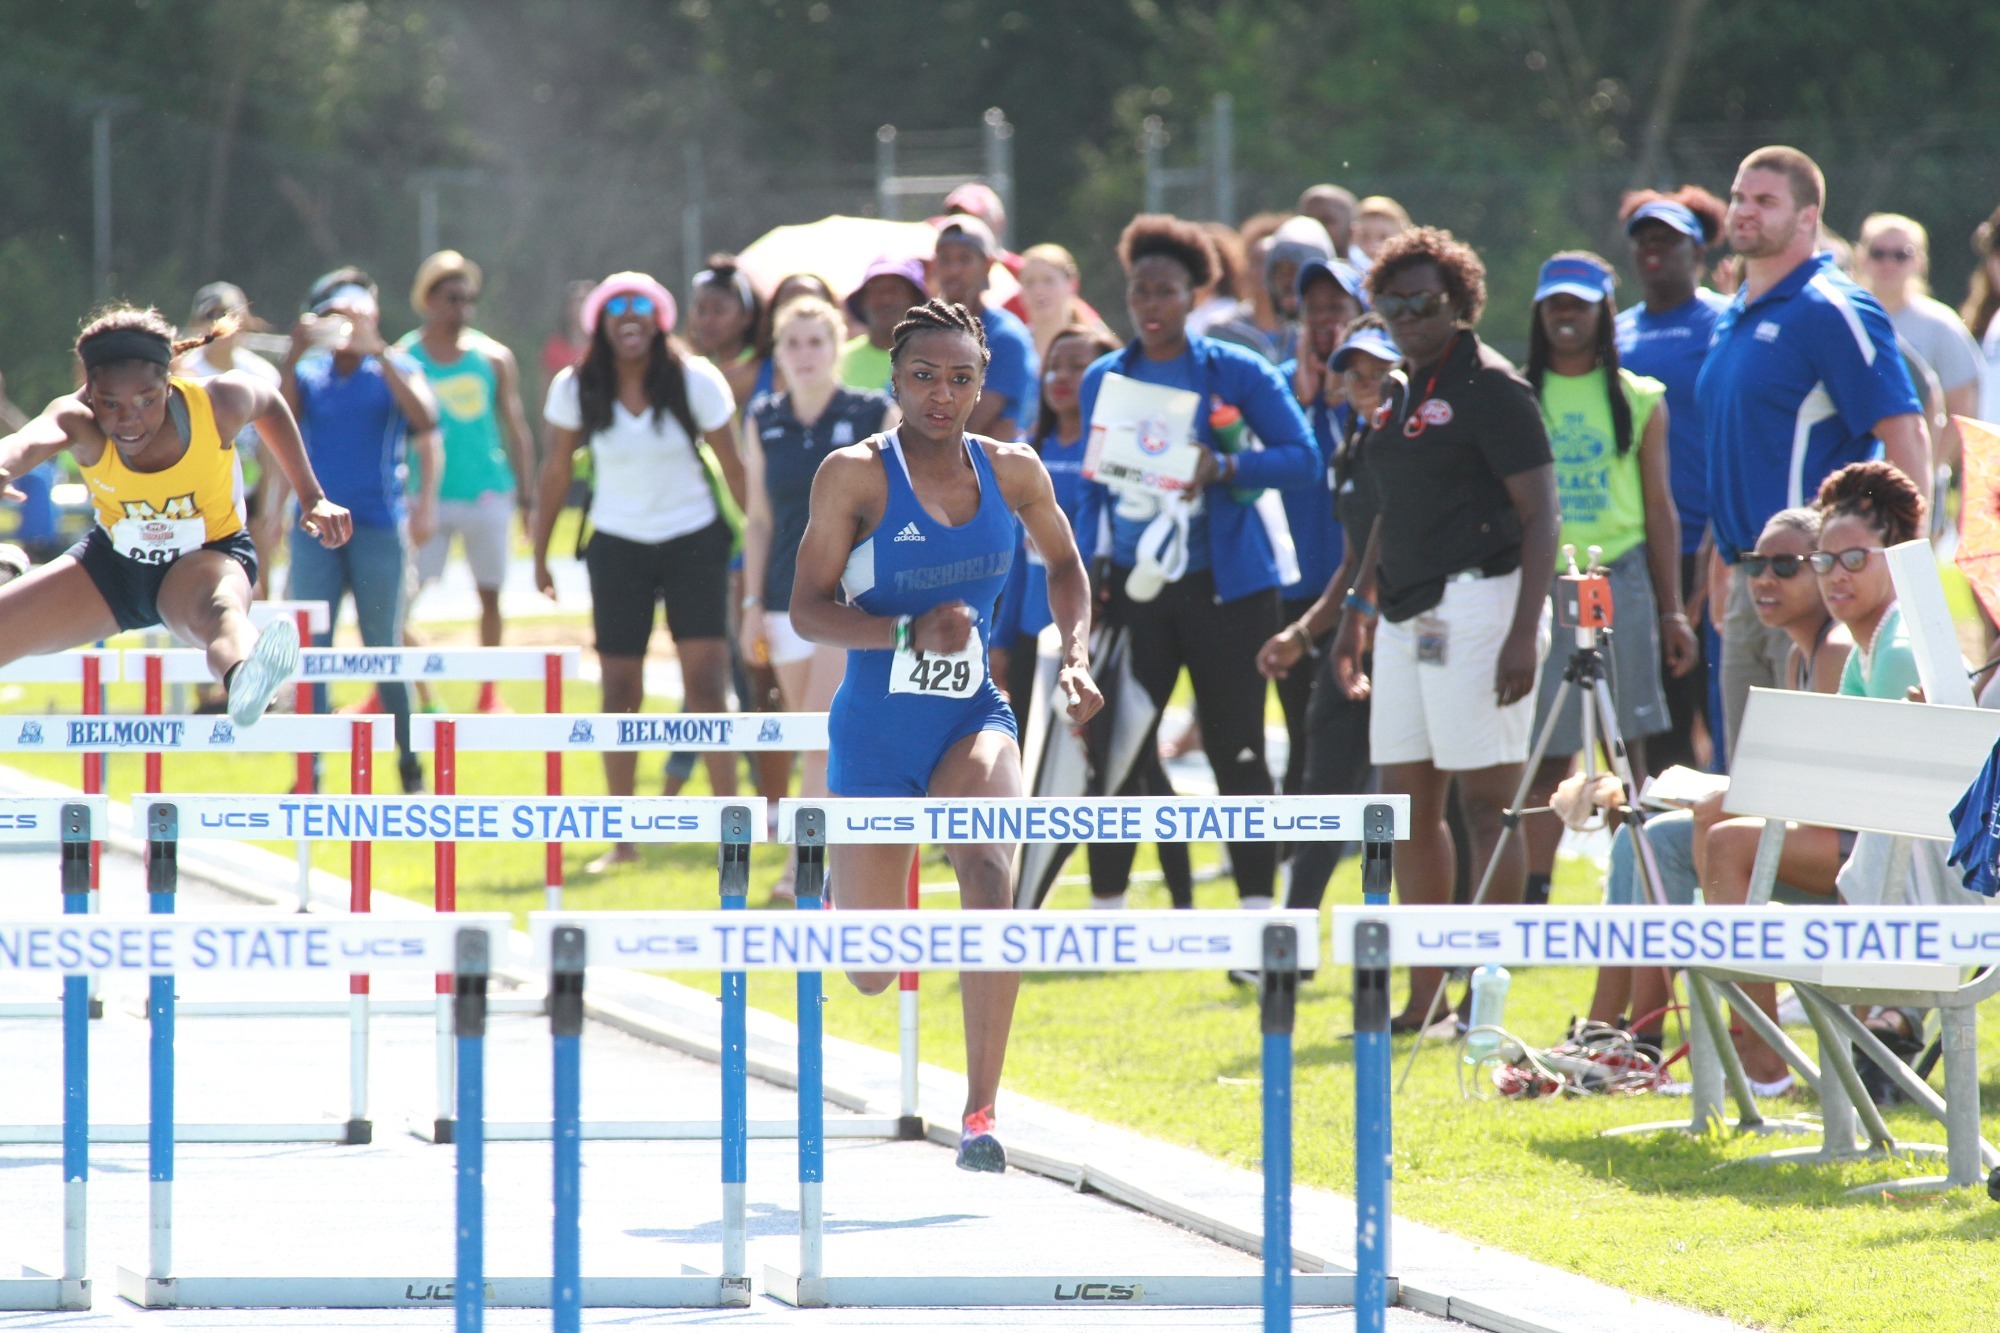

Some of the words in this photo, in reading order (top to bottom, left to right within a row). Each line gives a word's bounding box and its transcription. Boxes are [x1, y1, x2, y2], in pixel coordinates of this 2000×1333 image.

[894, 533, 926, 542] adidas
[303, 653, 402, 676] BELMONT
[909, 660, 971, 692] 429
[67, 720, 184, 747] BELMONT
[617, 719, 733, 745] BELMONT
[200, 813, 270, 828] UCS
[279, 804, 499, 838] TENNESSEE
[511, 804, 623, 839] STATE
[631, 815, 699, 830] UCS
[847, 816, 915, 831] UCS
[924, 806, 1142, 840] TENNESSEE
[1154, 806, 1265, 840] STATE
[1273, 815, 1341, 830] UCS
[192, 928, 330, 968] STATE
[340, 938, 425, 956] UCS
[614, 935, 698, 954] UCS
[712, 924, 983, 964] TENNESSEE
[1001, 924, 1137, 964] STATE
[1149, 935, 1232, 953] UCS
[1417, 930, 1501, 949] UCS
[1514, 920, 1785, 960] TENNESSEE
[1803, 920, 1940, 960] STATE
[405, 1284, 457, 1300] UC
[1054, 1284, 1134, 1301] UCS
